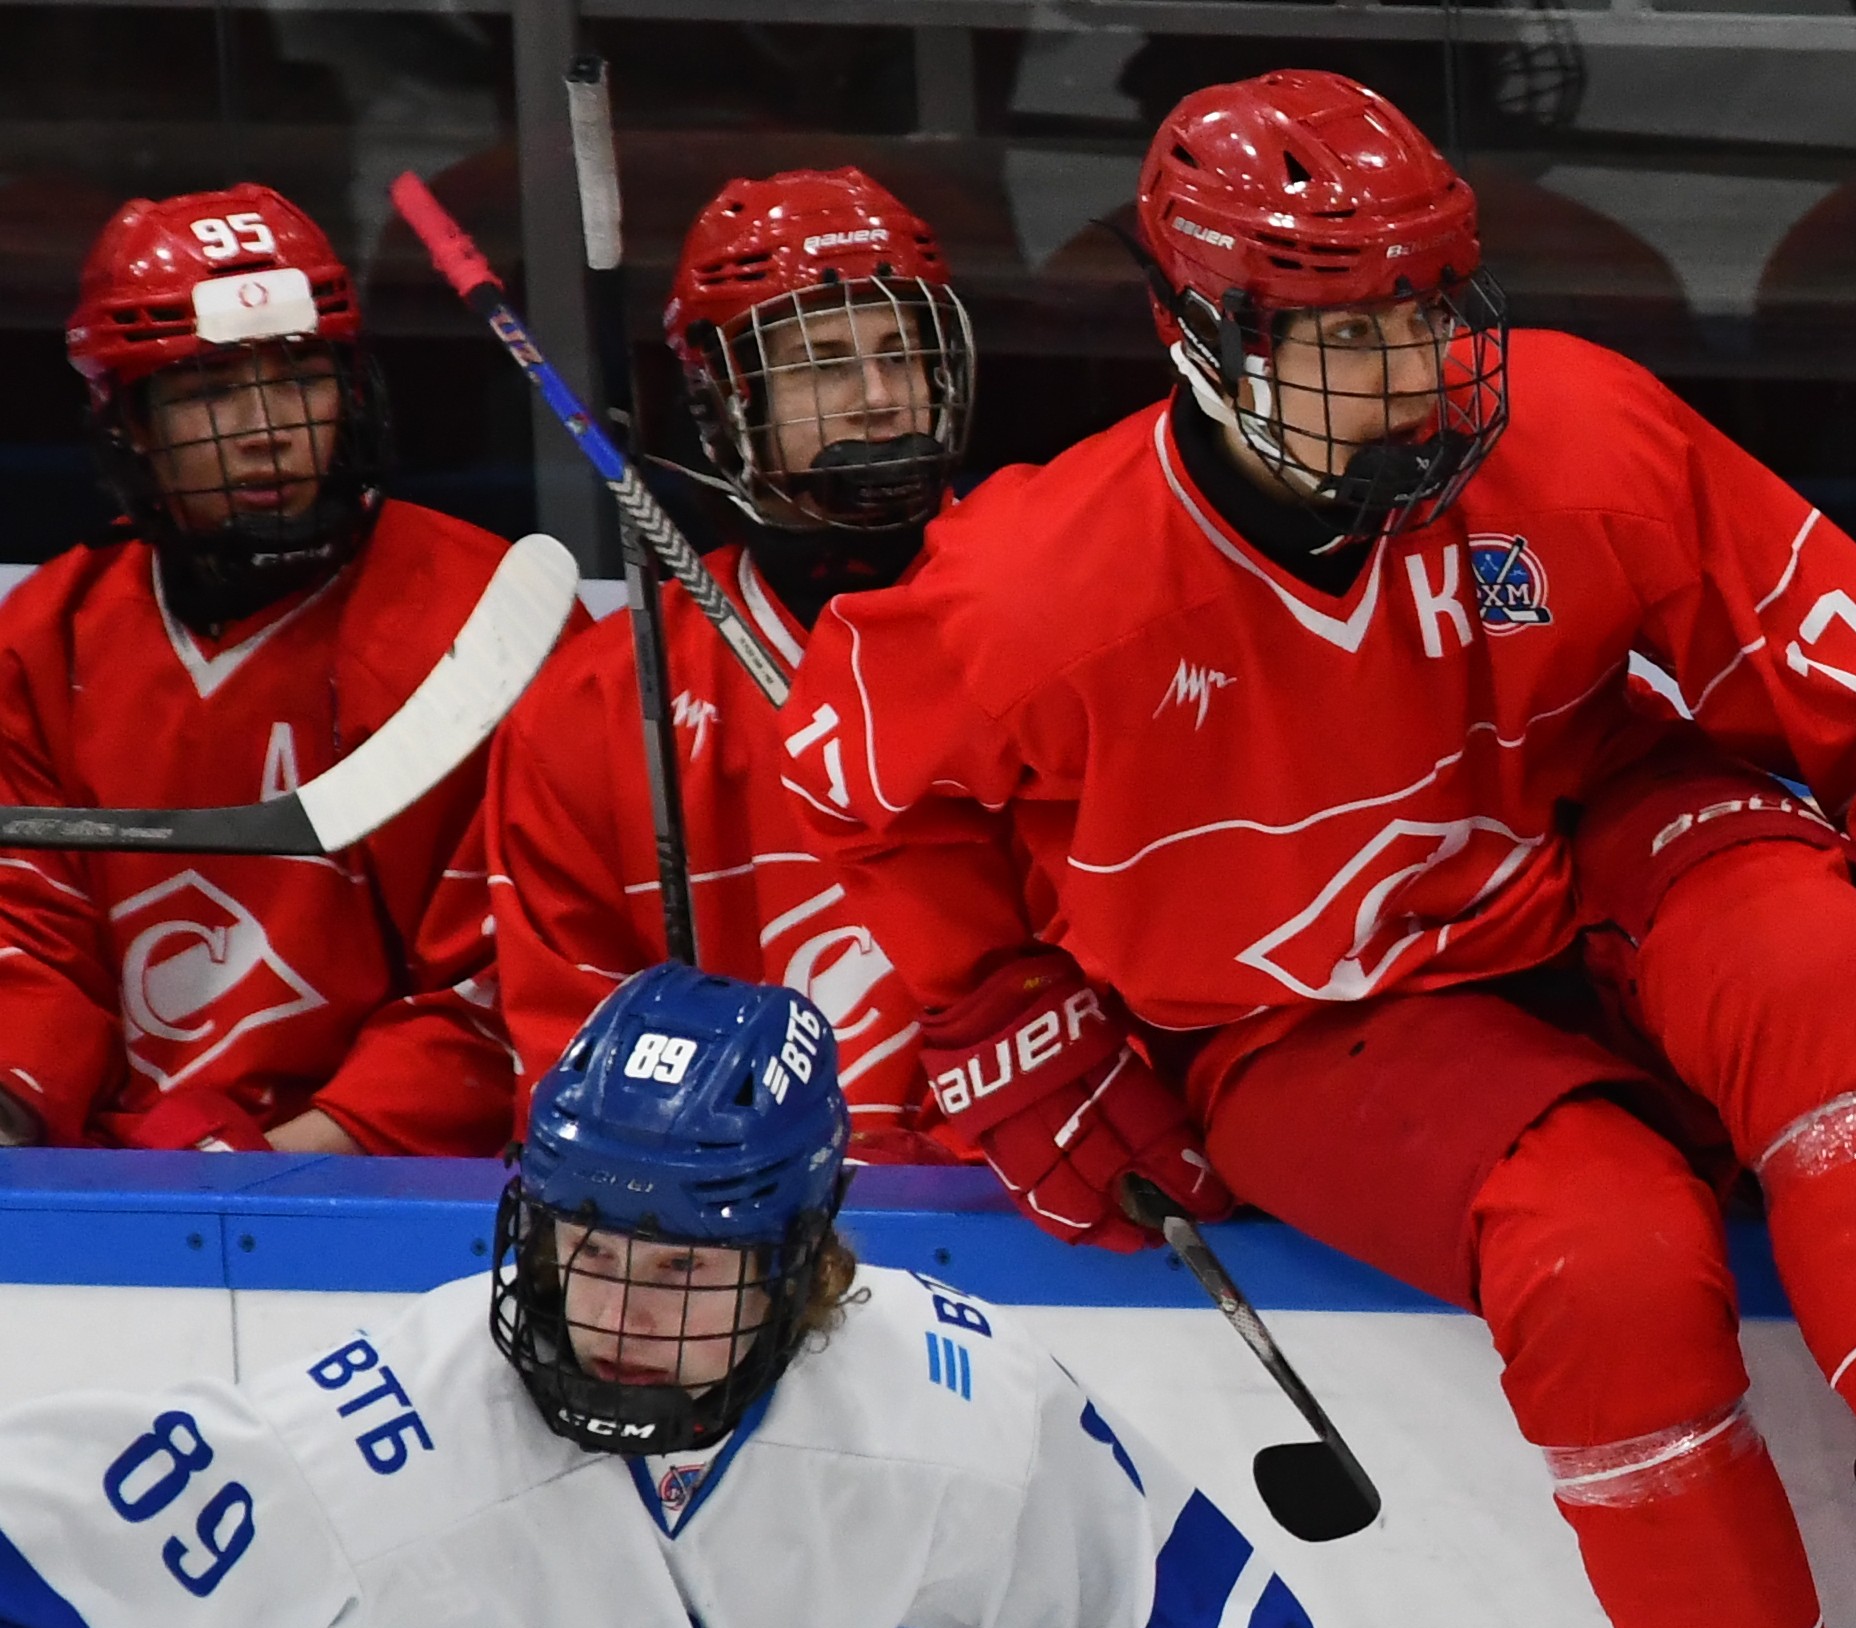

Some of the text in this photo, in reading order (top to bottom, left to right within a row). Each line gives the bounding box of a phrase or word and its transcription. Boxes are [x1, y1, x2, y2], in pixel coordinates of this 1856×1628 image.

[190, 212, 276, 260] 95
[803, 227, 889, 254] BAUER
[1172, 215, 1236, 250] BAUER
[1404, 543, 1474, 658] К
[1475, 582, 1533, 608] ХМ
[624, 1033, 698, 1085] 89
[781, 999, 821, 1086] ВТБ
[929, 987, 1106, 1114] AUER
[306, 1337, 436, 1477] ВТБ
[103, 1410, 257, 1599] 89
